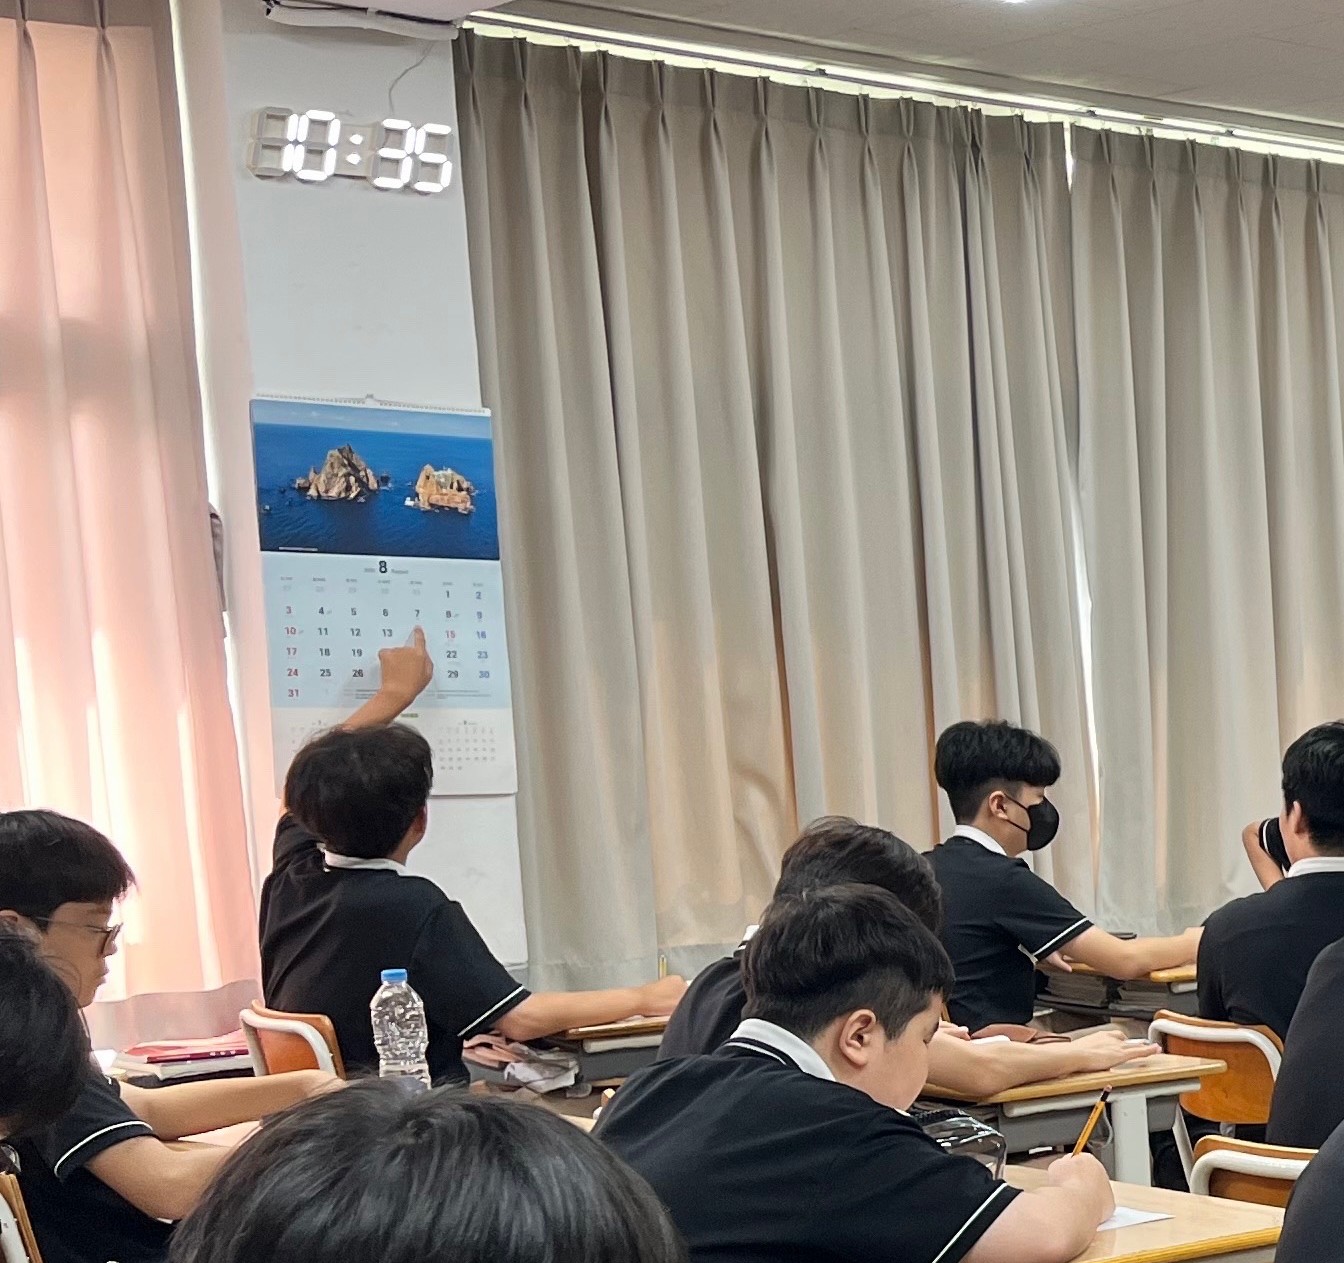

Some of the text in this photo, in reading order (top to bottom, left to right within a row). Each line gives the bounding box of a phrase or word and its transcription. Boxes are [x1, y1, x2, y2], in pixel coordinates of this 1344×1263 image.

[283, 109, 453, 192] 10:35
[379, 560, 387, 573] 8
[476, 591, 481, 599] 2
[286, 606, 292, 614] 3
[351, 608, 357, 616] 5
[285, 627, 296, 635] 10
[351, 628, 360, 636] 12
[382, 629, 392, 637] 13
[446, 630, 455, 638] 15
[286, 647, 297, 655] 17
[320, 648, 331, 656] 18
[352, 649, 362, 657] 19
[447, 650, 457, 658] 22
[320, 669, 332, 677] 25
[353, 669, 363, 677] 26
[288, 689, 299, 697] 31
